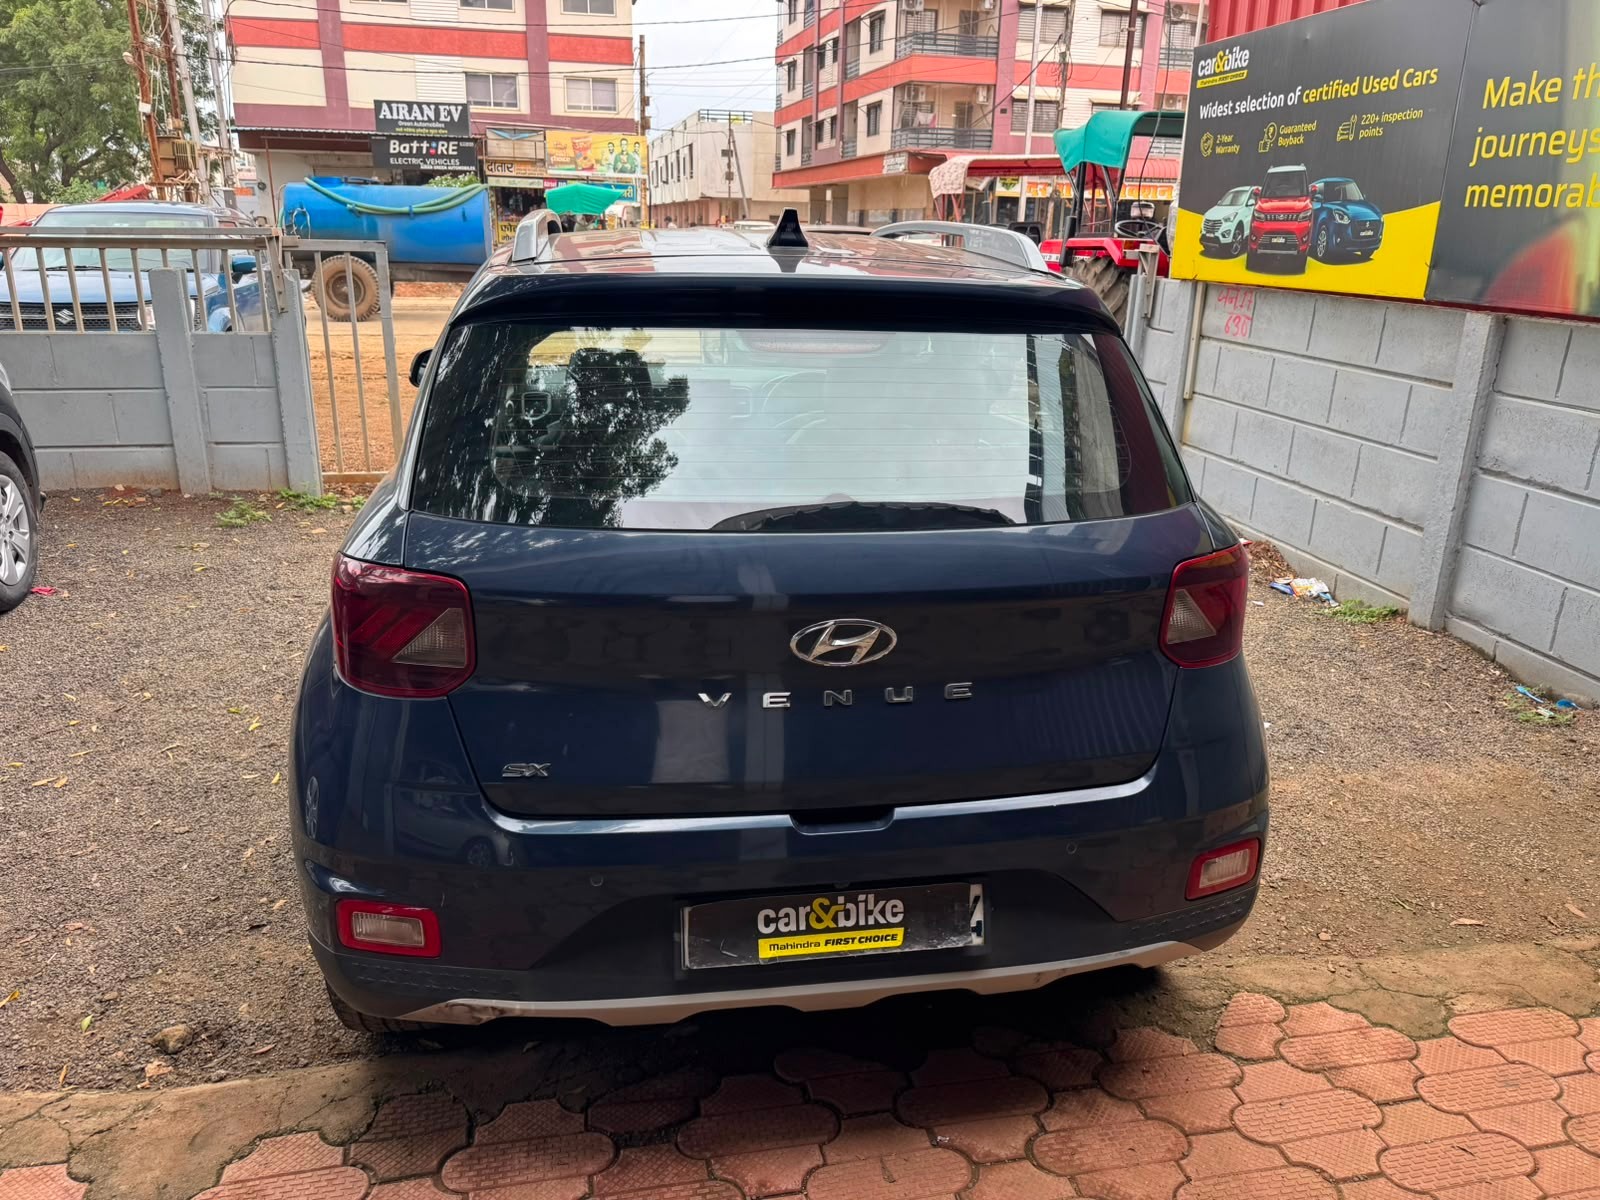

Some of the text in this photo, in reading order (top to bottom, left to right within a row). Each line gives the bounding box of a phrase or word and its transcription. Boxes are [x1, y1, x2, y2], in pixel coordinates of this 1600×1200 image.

[1198, 46, 1249, 76] car&bike
[1199, 68, 1438, 119] Widest selection of certified Used Cars
[1482, 70, 1562, 109] Make
[379, 102, 463, 122] AIRAN EV
[1360, 107, 1424, 126] 220+ inspection
[1279, 120, 1317, 135] Guaranteed
[1358, 126, 1384, 140] points
[1215, 134, 1234, 144] 2-Year
[1277, 134, 1304, 148] Buyback
[1469, 126, 1600, 167] journeys
[1215, 144, 1240, 155] Warranty
[389, 157, 460, 166] ELECTRIC VEHICLES
[1464, 172, 1600, 208] memorab
[698, 682, 973, 708] VENUE
[502, 763, 551, 777] SX
[757, 893, 904, 935] car&bike
[769, 933, 898, 952] Mahindra FIRST CHOICE
